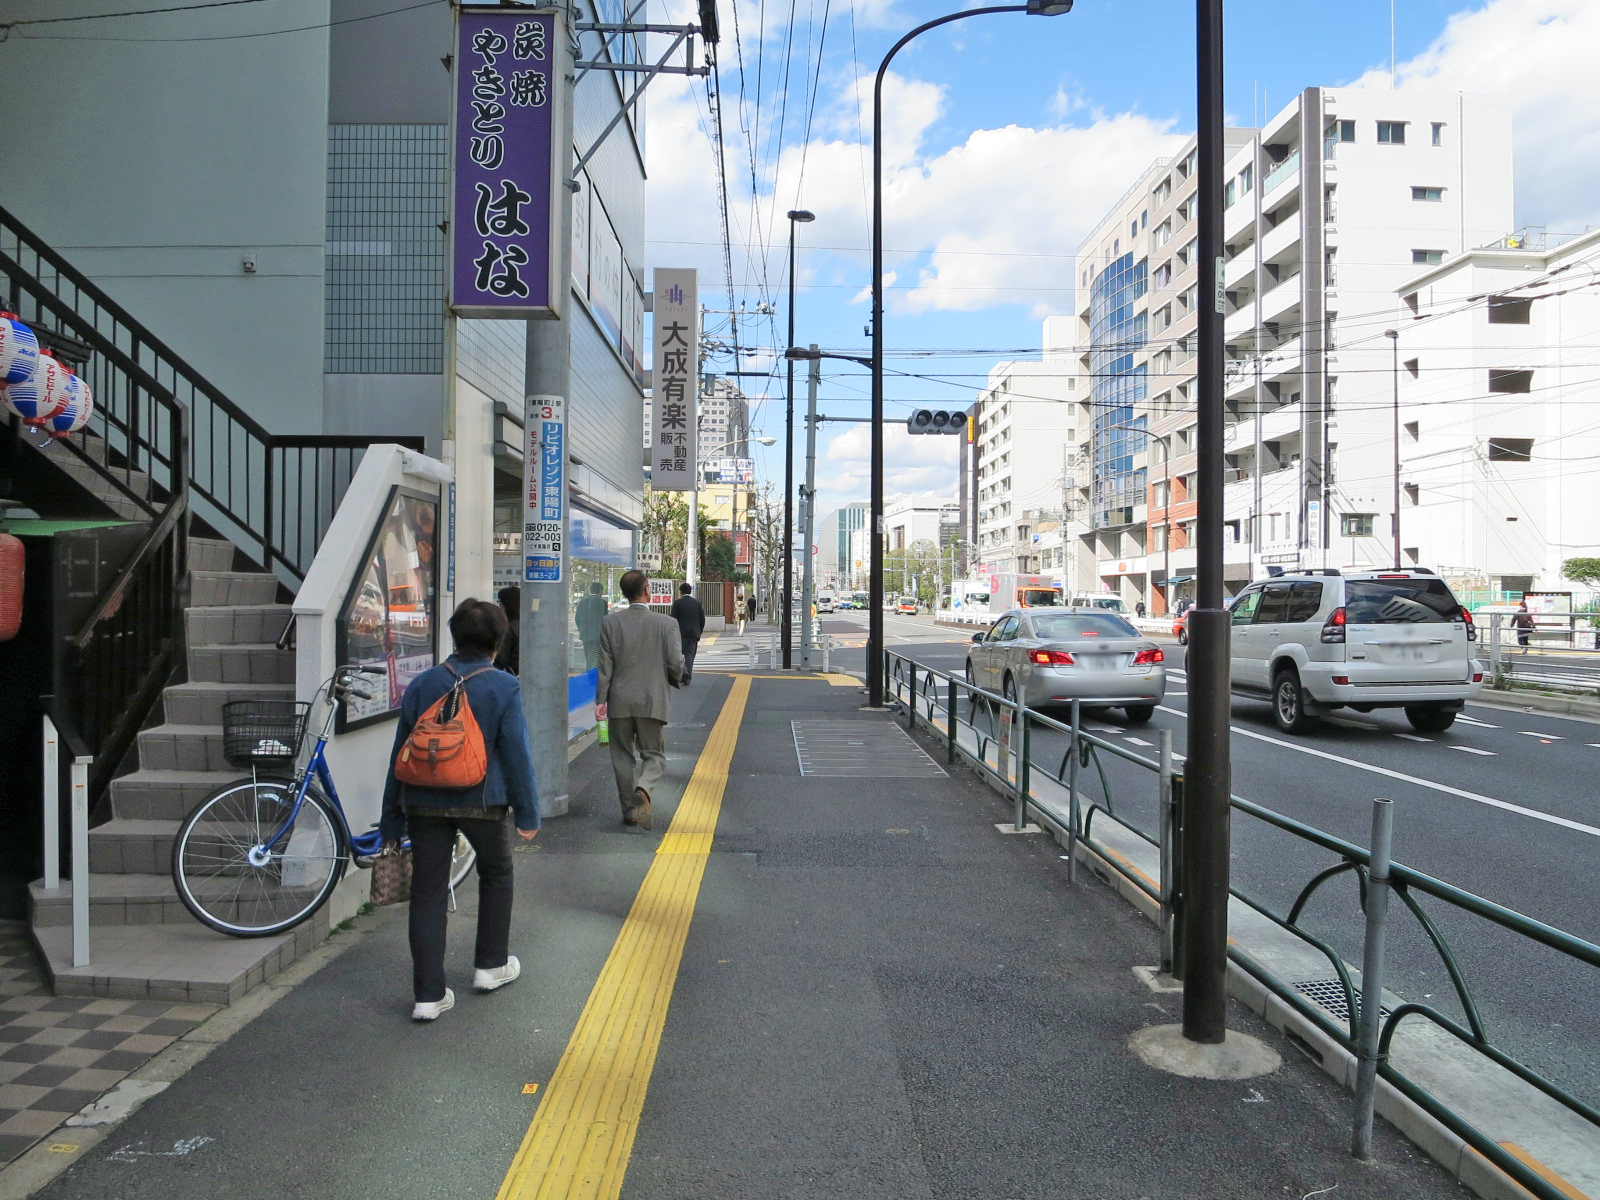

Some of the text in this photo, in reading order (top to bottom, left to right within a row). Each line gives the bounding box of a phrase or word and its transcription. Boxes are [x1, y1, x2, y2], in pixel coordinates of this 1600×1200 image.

[470, 28, 508, 170] やきとり
[510, 22, 547, 107] 炭焼
[473, 179, 532, 299] はな
[661, 320, 689, 430] 大成有楽
[529, 430, 537, 509] モデルルーム公開中
[544, 423, 561, 519] リビオレゾン東陽町
[674, 432, 687, 472] 不動産
[525, 532, 561, 541] 022-003
[537, 523, 561, 532] 0120-
